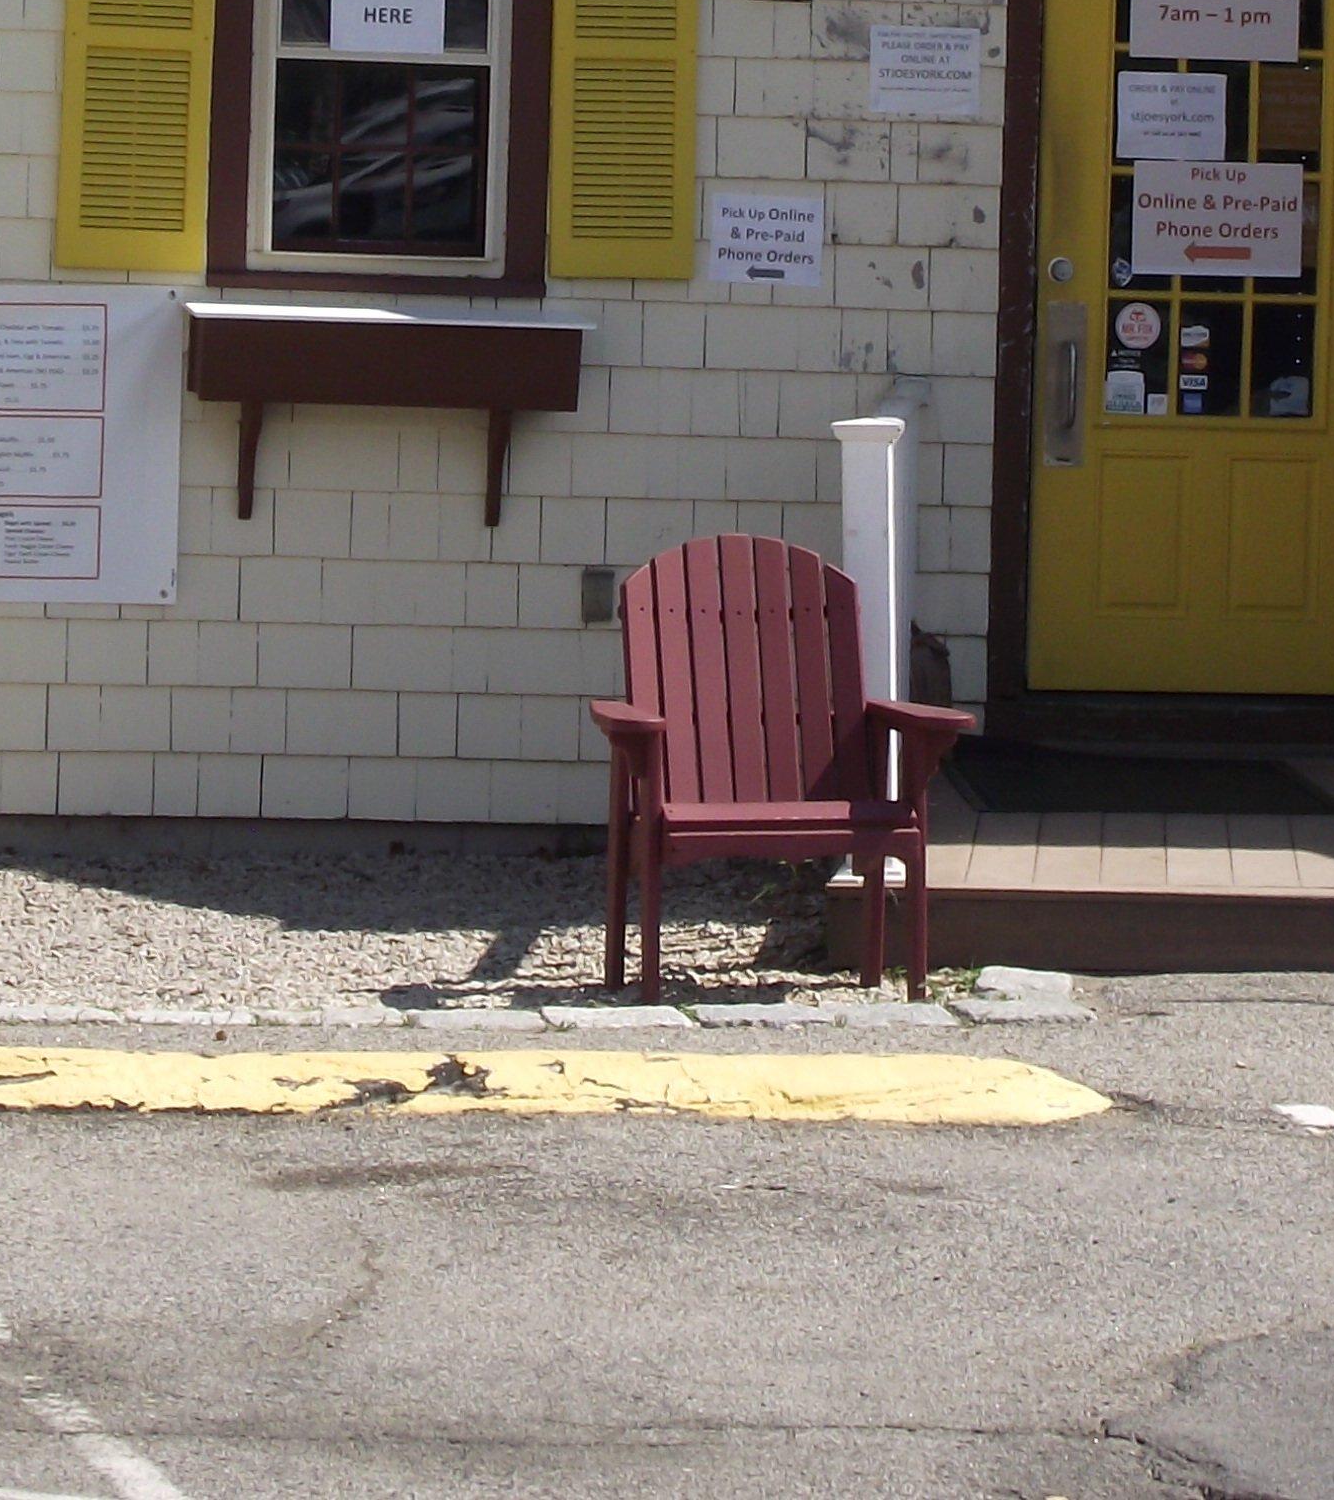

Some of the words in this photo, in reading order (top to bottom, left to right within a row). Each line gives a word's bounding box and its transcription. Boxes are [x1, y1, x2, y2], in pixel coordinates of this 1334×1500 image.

[363, 6, 414, 25] HERE
[1158, 4, 1200, 22] 7am
[1224, 7, 1235, 23] 1
[1240, 9, 1271, 27] pm
[913, 42, 942, 51] ORDER
[954, 43, 971, 52] PAY
[900, 54, 936, 64] ONLINE
[937, 55, 951, 64] AT
[1190, 167, 1221, 182] Pick
[1225, 168, 1247, 184] Up
[1137, 192, 1197, 210] Online
[1202, 193, 1216, 210] &
[1222, 194, 1299, 212] Pre-Paid
[722, 206, 745, 218] Pick
[748, 208, 766, 221] Up
[768, 207, 815, 223] Online
[730, 226, 741, 240] &
[745, 227, 806, 243] Pre-Paid
[1155, 220, 1213, 238] Phone
[1218, 222, 1280, 240] Orders
[717, 246, 763, 262] Phone
[766, 249, 815, 266] Orders
[1182, 376, 1206, 387] VISA
